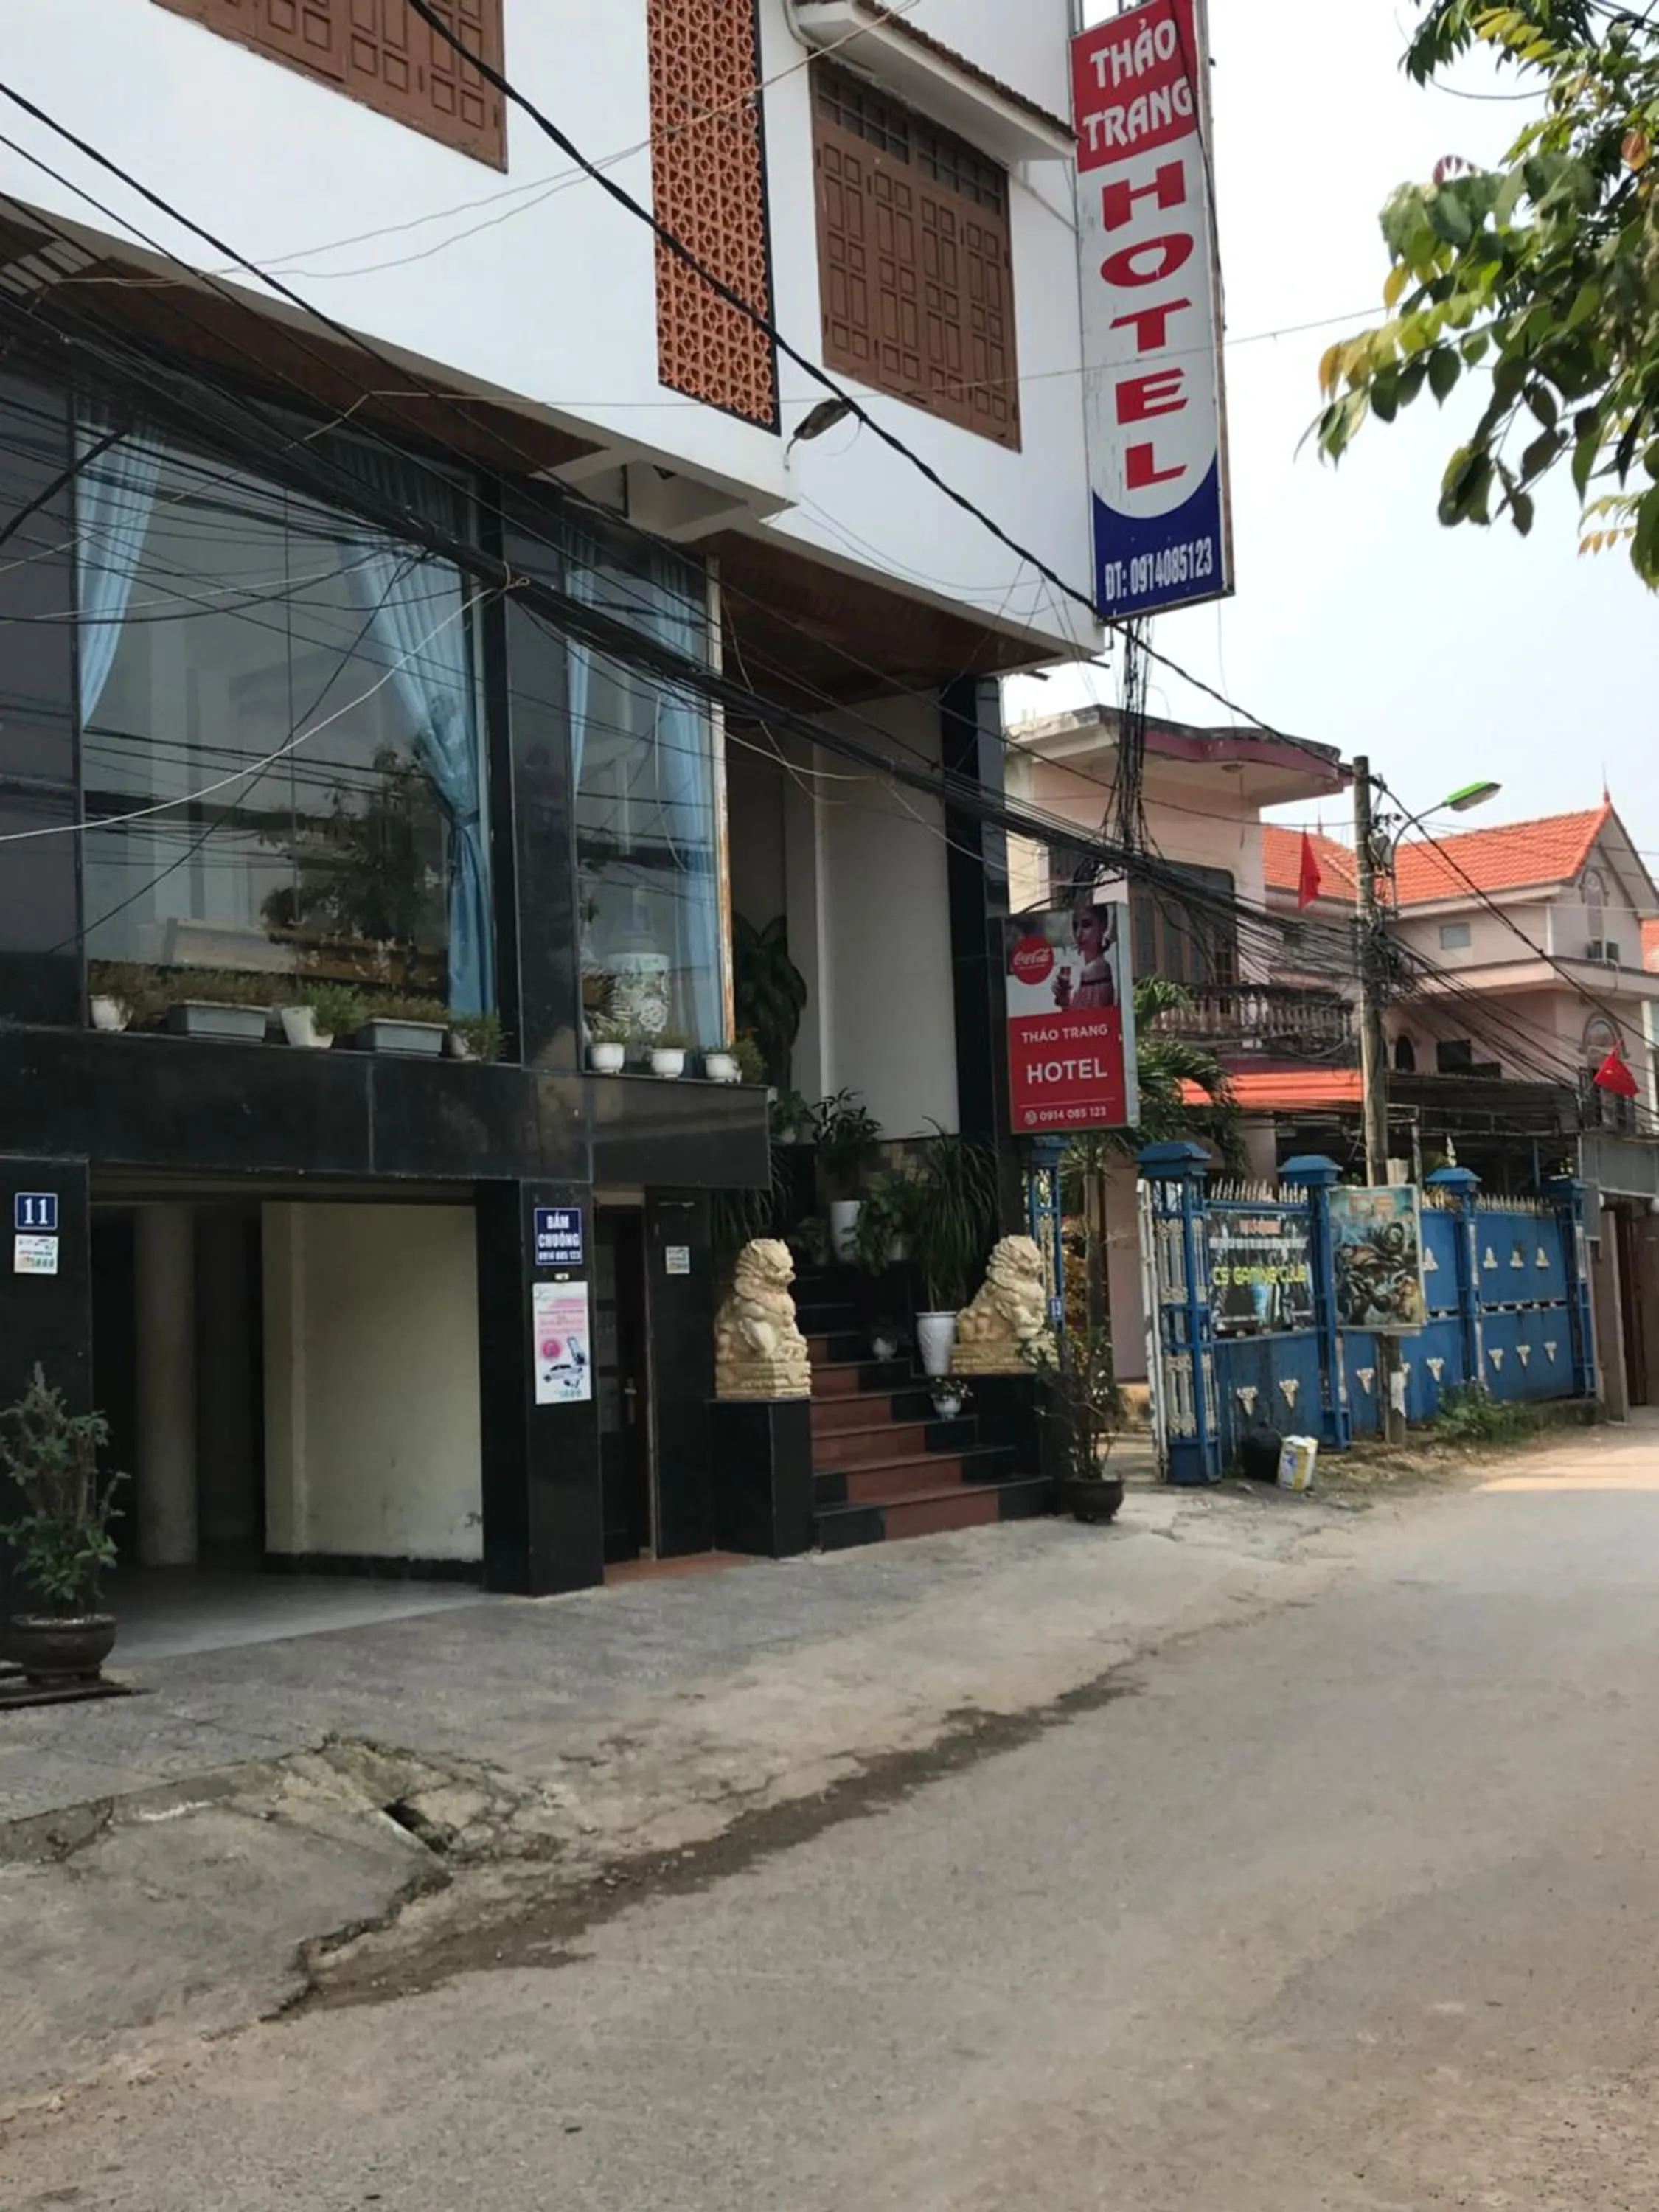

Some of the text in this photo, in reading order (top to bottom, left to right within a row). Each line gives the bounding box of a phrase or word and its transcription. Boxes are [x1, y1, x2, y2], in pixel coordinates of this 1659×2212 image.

[1090, 18, 1177, 88] THẢO
[1082, 75, 1194, 152] TRANG
[1100, 159, 1194, 490] HOTEL
[1130, 536, 1213, 595] 0914085123
[1062, 1023, 1107, 1040] TRANG
[1027, 1057, 1107, 1084] HOTEL
[1040, 1110, 1065, 1121] 0914
[1089, 1105, 1107, 1118] 123
[24, 1197, 48, 1224] 11
